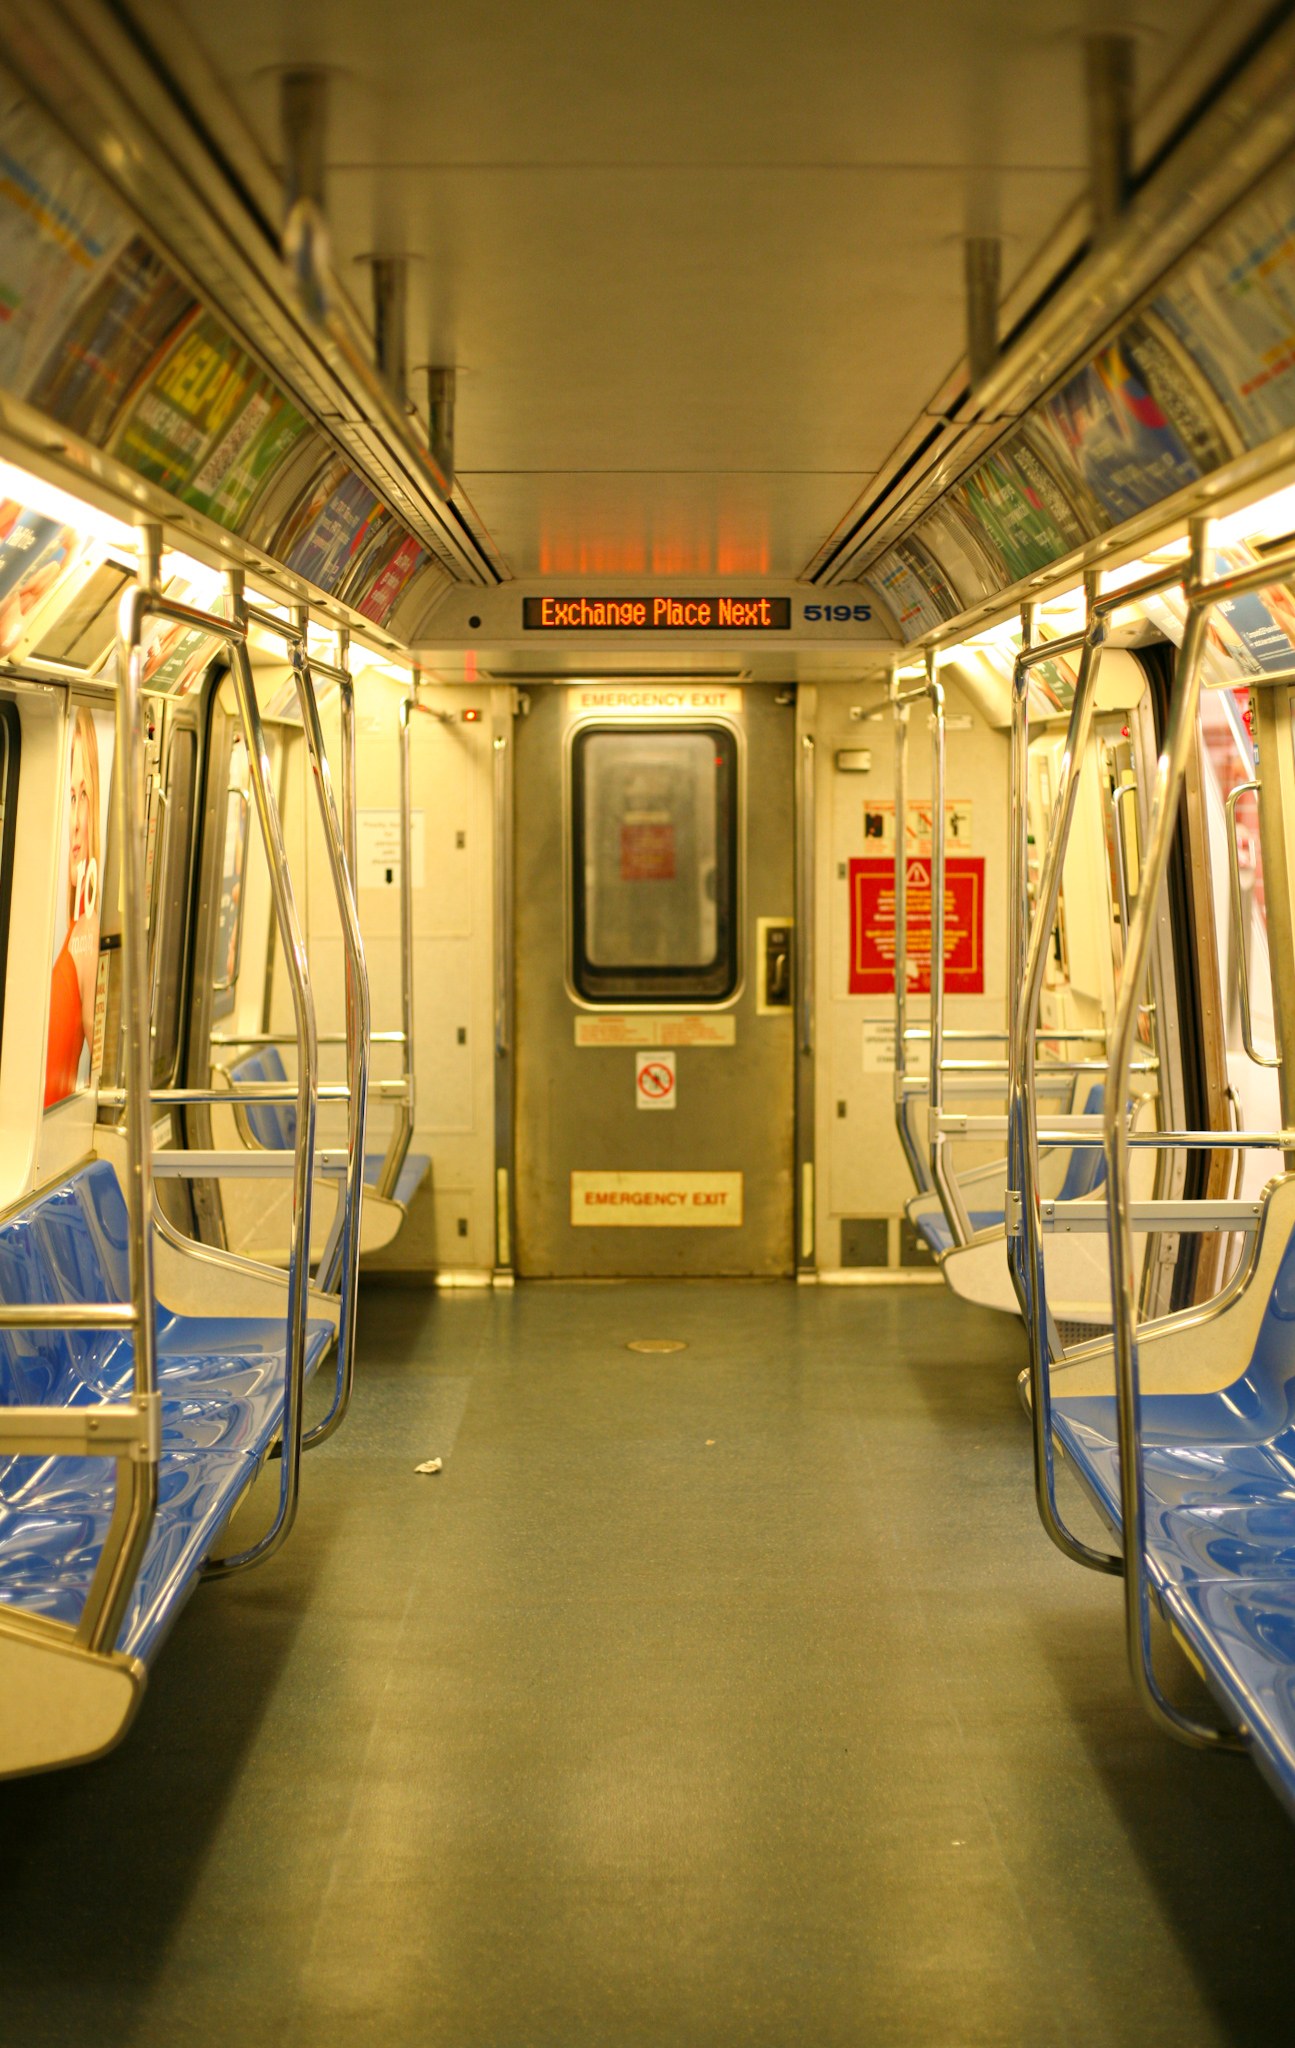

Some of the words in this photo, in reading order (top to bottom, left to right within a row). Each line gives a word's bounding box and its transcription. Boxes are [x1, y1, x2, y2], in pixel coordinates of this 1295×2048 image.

[541, 598, 646, 626] Exchange
[653, 598, 711, 626] Place
[718, 598, 772, 626] Next
[803, 605, 872, 622] 5195
[581, 692, 685, 707] EMERGENCY
[690, 692, 726, 707] EXIT
[584, 1191, 688, 1206] EMERGENCY
[692, 1191, 728, 1206] EXIT
